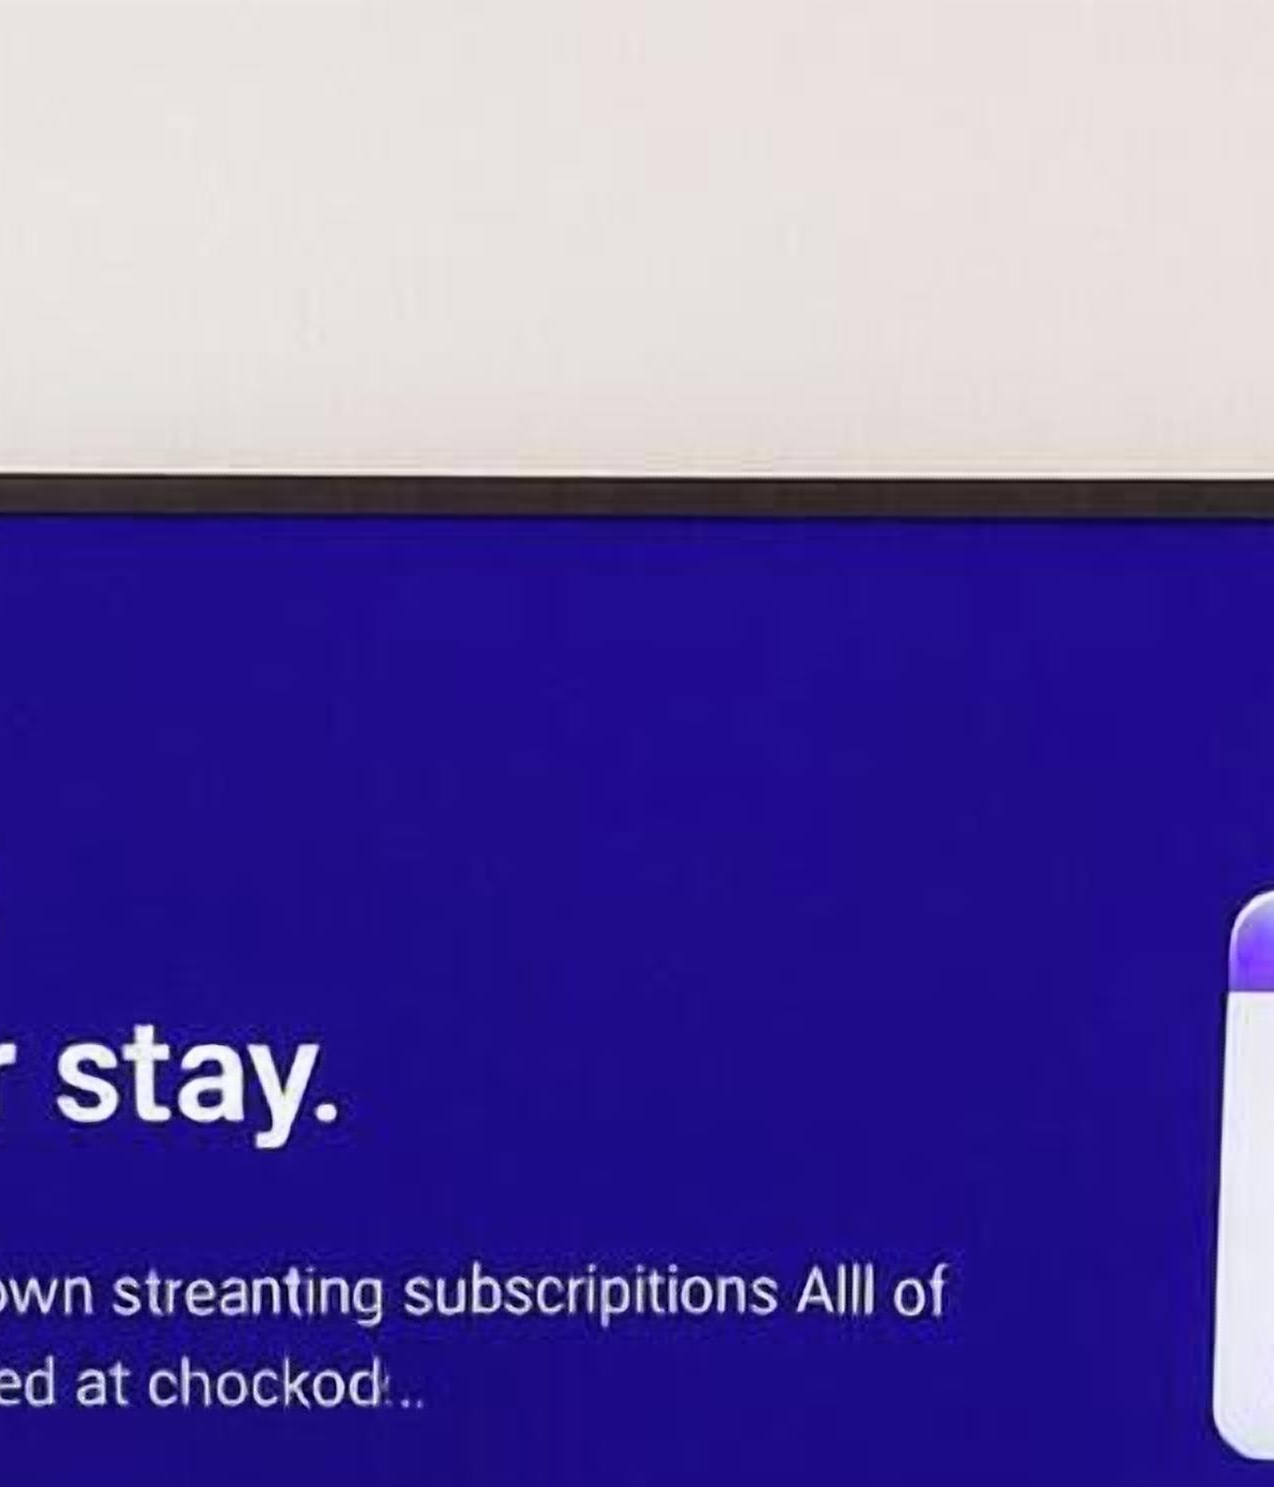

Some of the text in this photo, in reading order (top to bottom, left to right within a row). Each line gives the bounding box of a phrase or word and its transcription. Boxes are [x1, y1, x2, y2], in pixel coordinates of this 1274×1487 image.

[56, 1023, 338, 1150] stay.
[893, 1262, 949, 1317] of
[76, 1361, 131, 1407] at
